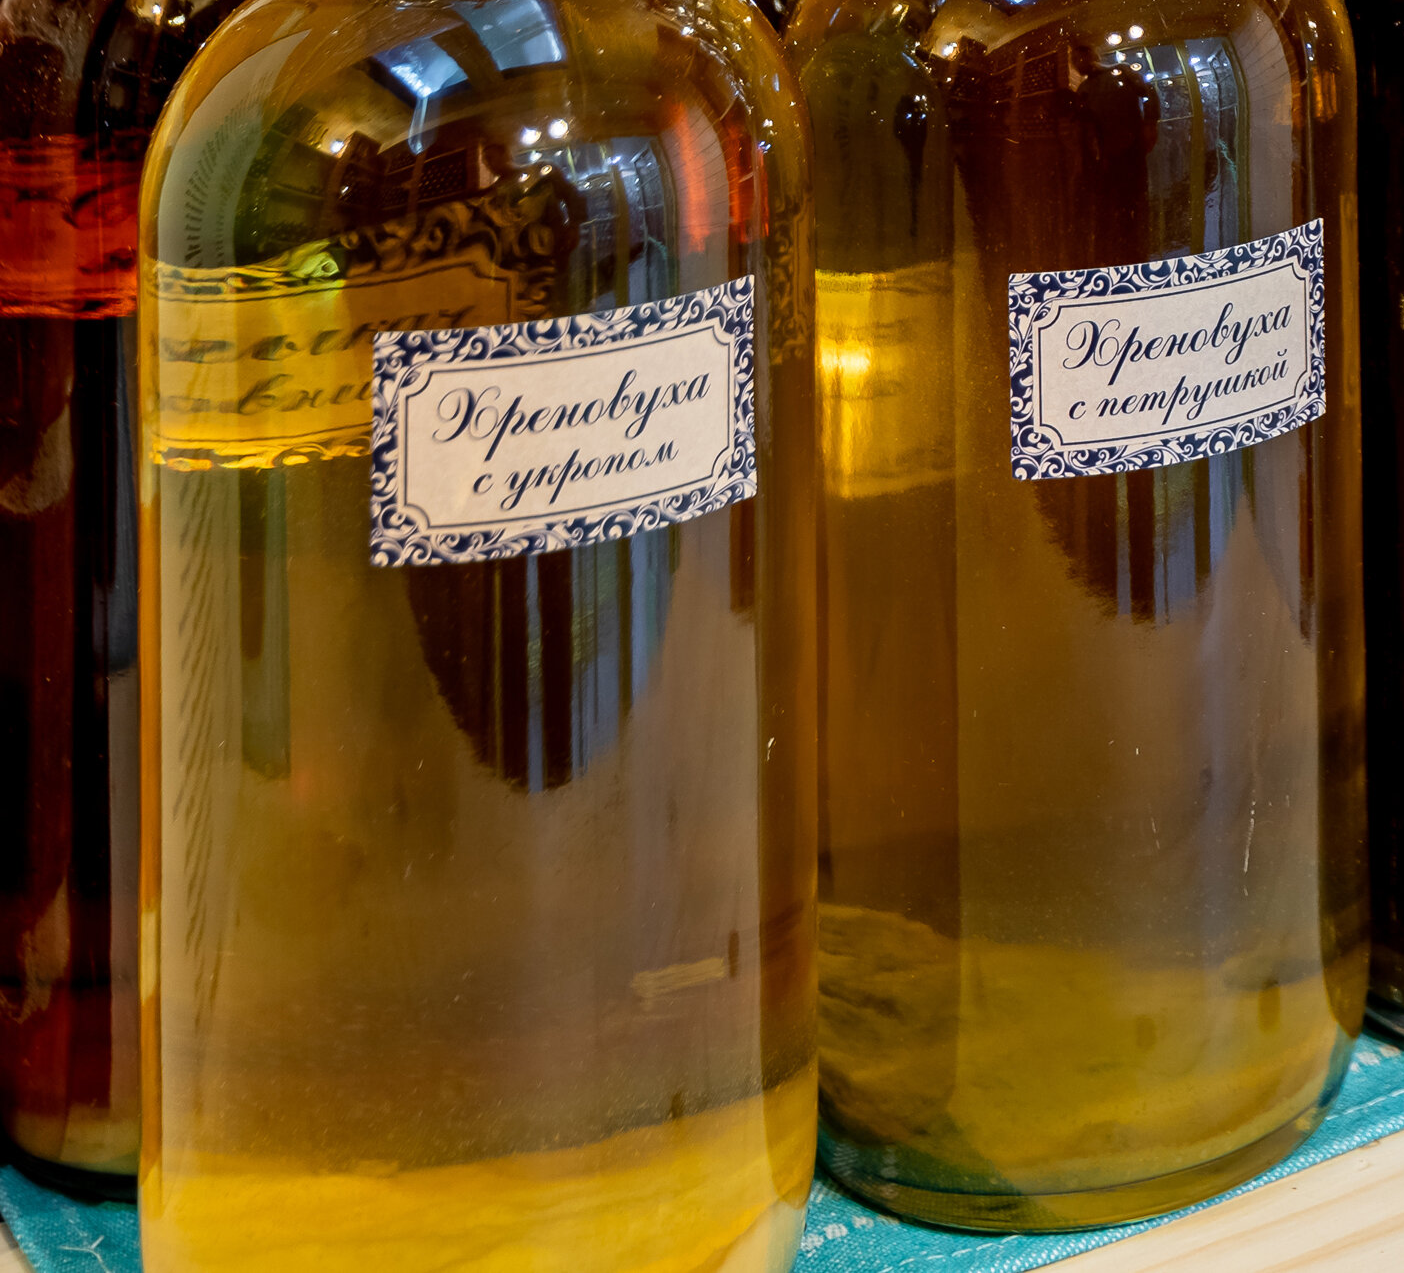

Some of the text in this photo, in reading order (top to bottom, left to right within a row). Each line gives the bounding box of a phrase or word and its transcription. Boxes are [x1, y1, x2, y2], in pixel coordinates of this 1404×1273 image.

[1062, 302, 1293, 385] Хреновуха
[432, 369, 711, 462] Хреновуха
[1069, 348, 1290, 425] с петрушкой
[473, 437, 680, 510] с укропом
